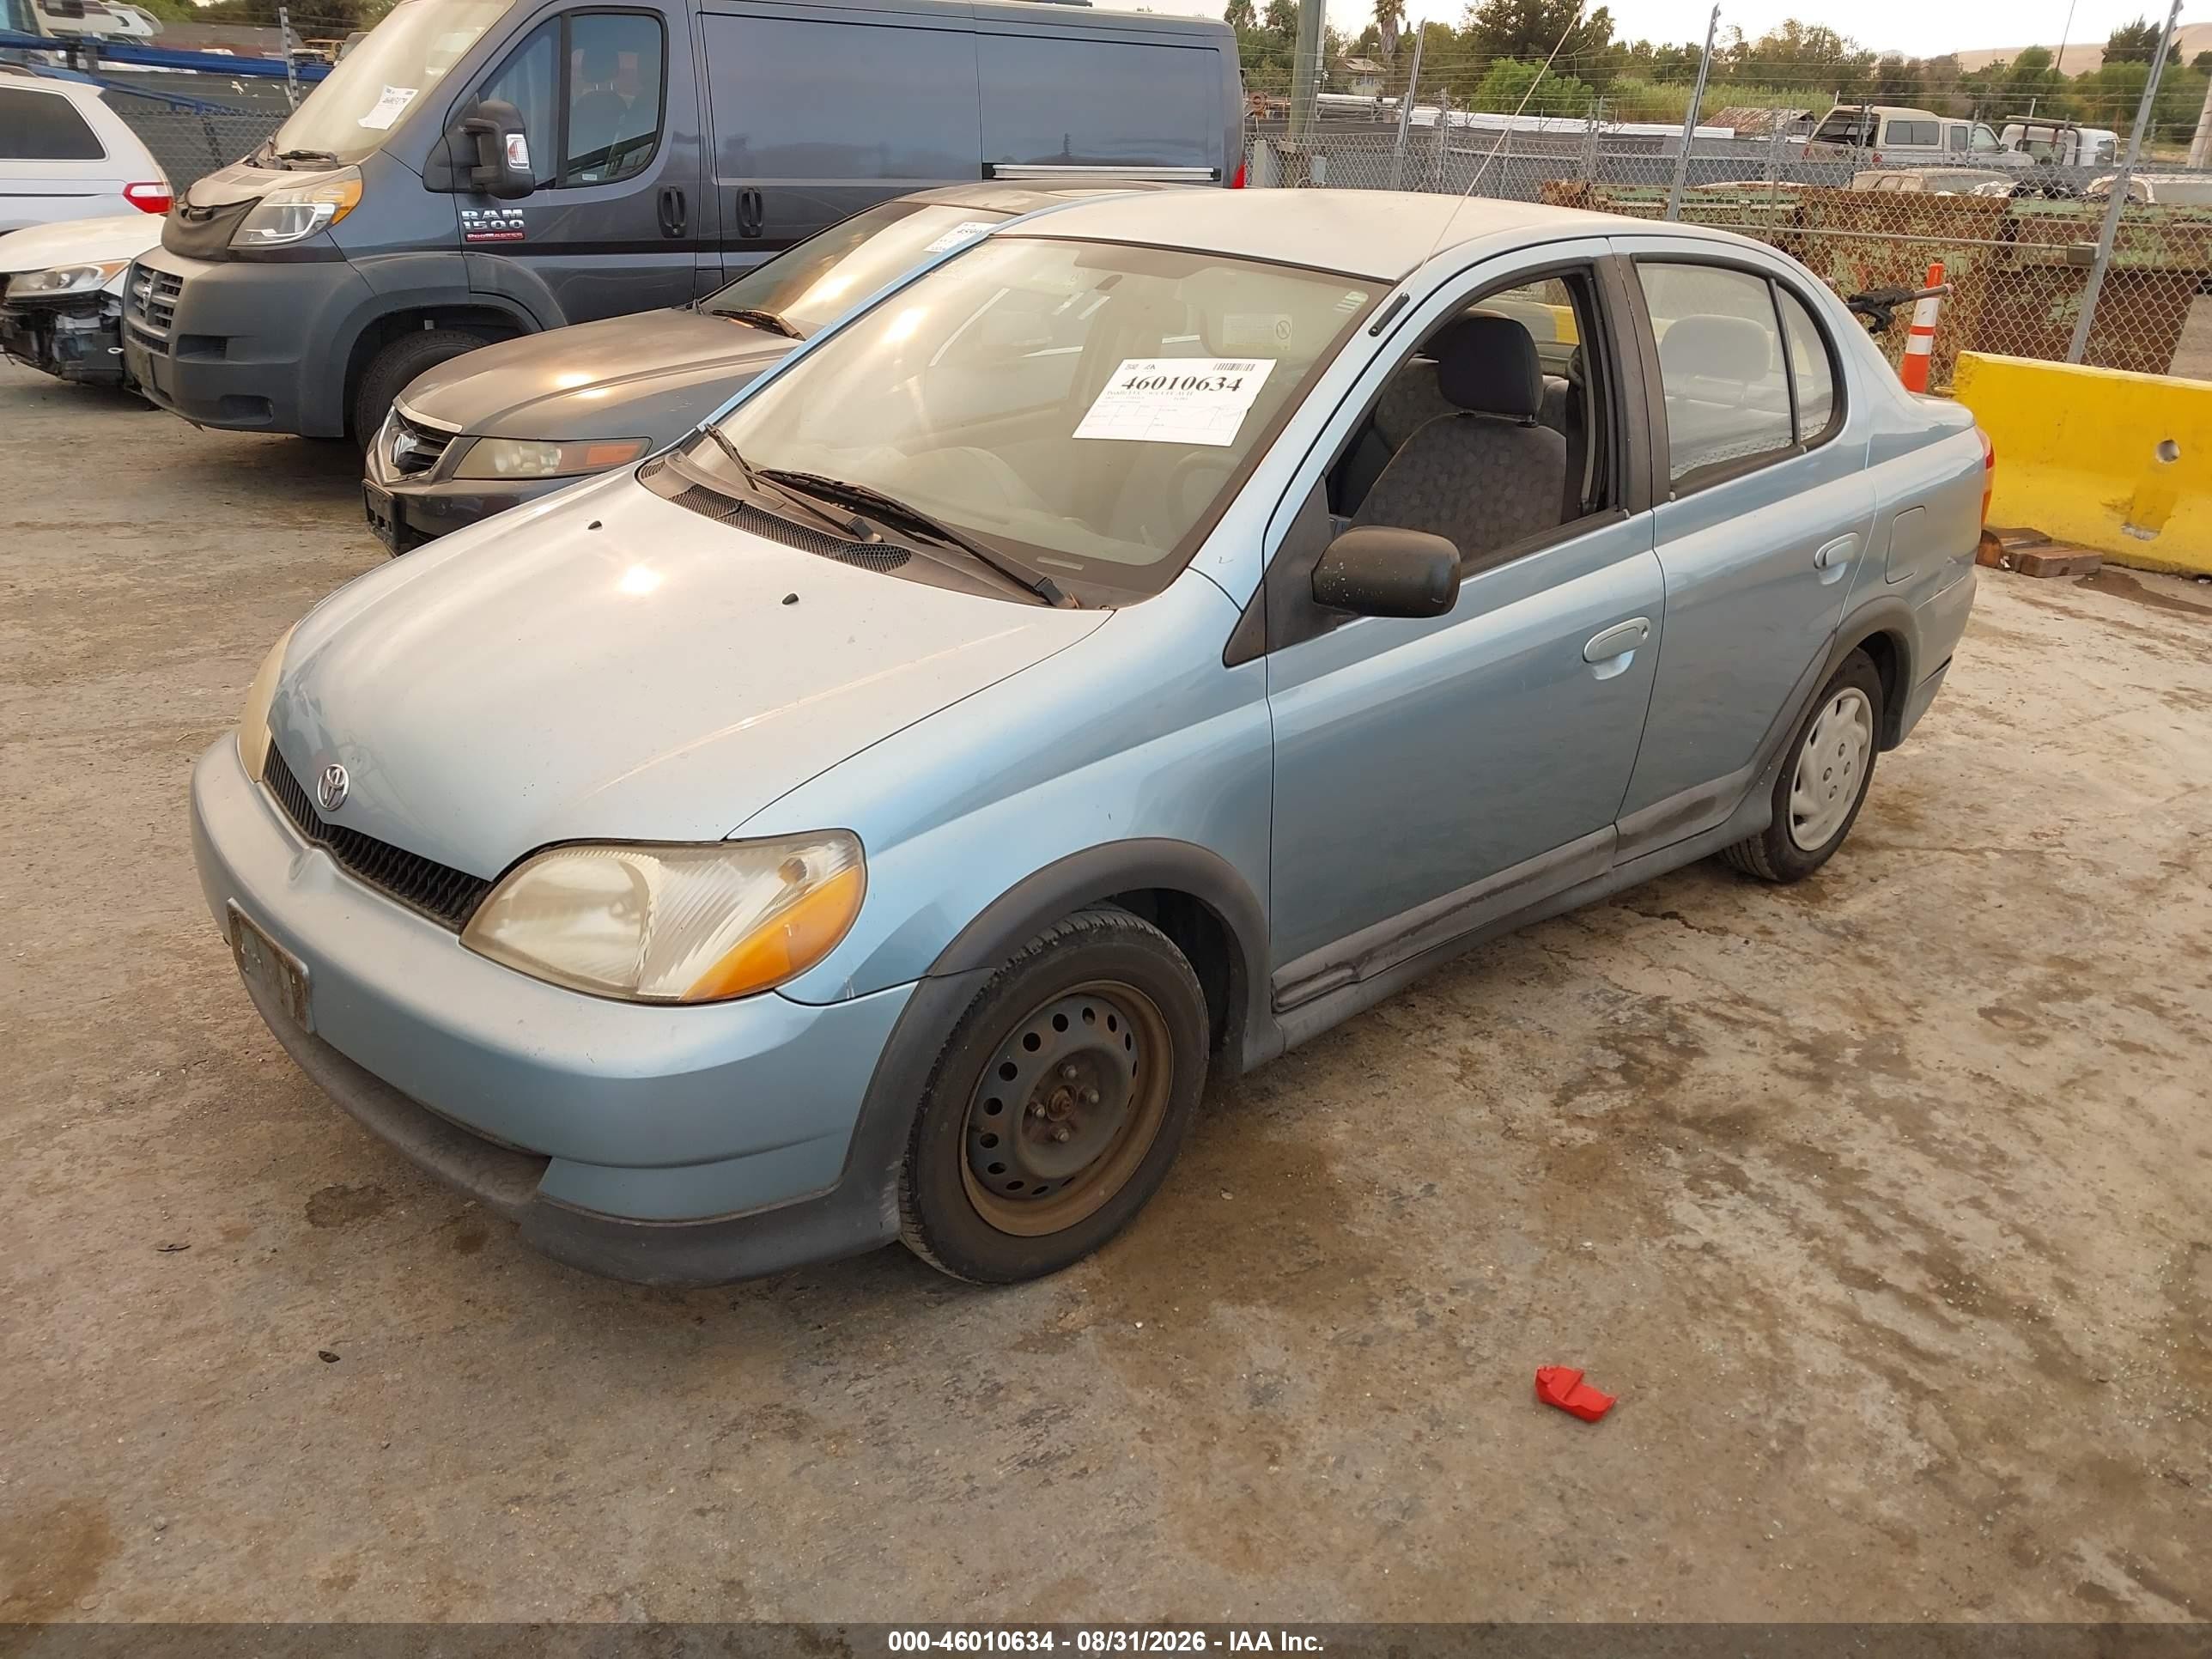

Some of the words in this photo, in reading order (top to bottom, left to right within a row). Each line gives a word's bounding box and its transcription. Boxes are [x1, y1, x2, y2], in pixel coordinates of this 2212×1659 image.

[461, 209, 523, 220] RAM
[464, 219, 525, 230] 1500
[1121, 375, 1243, 392] 46010634
